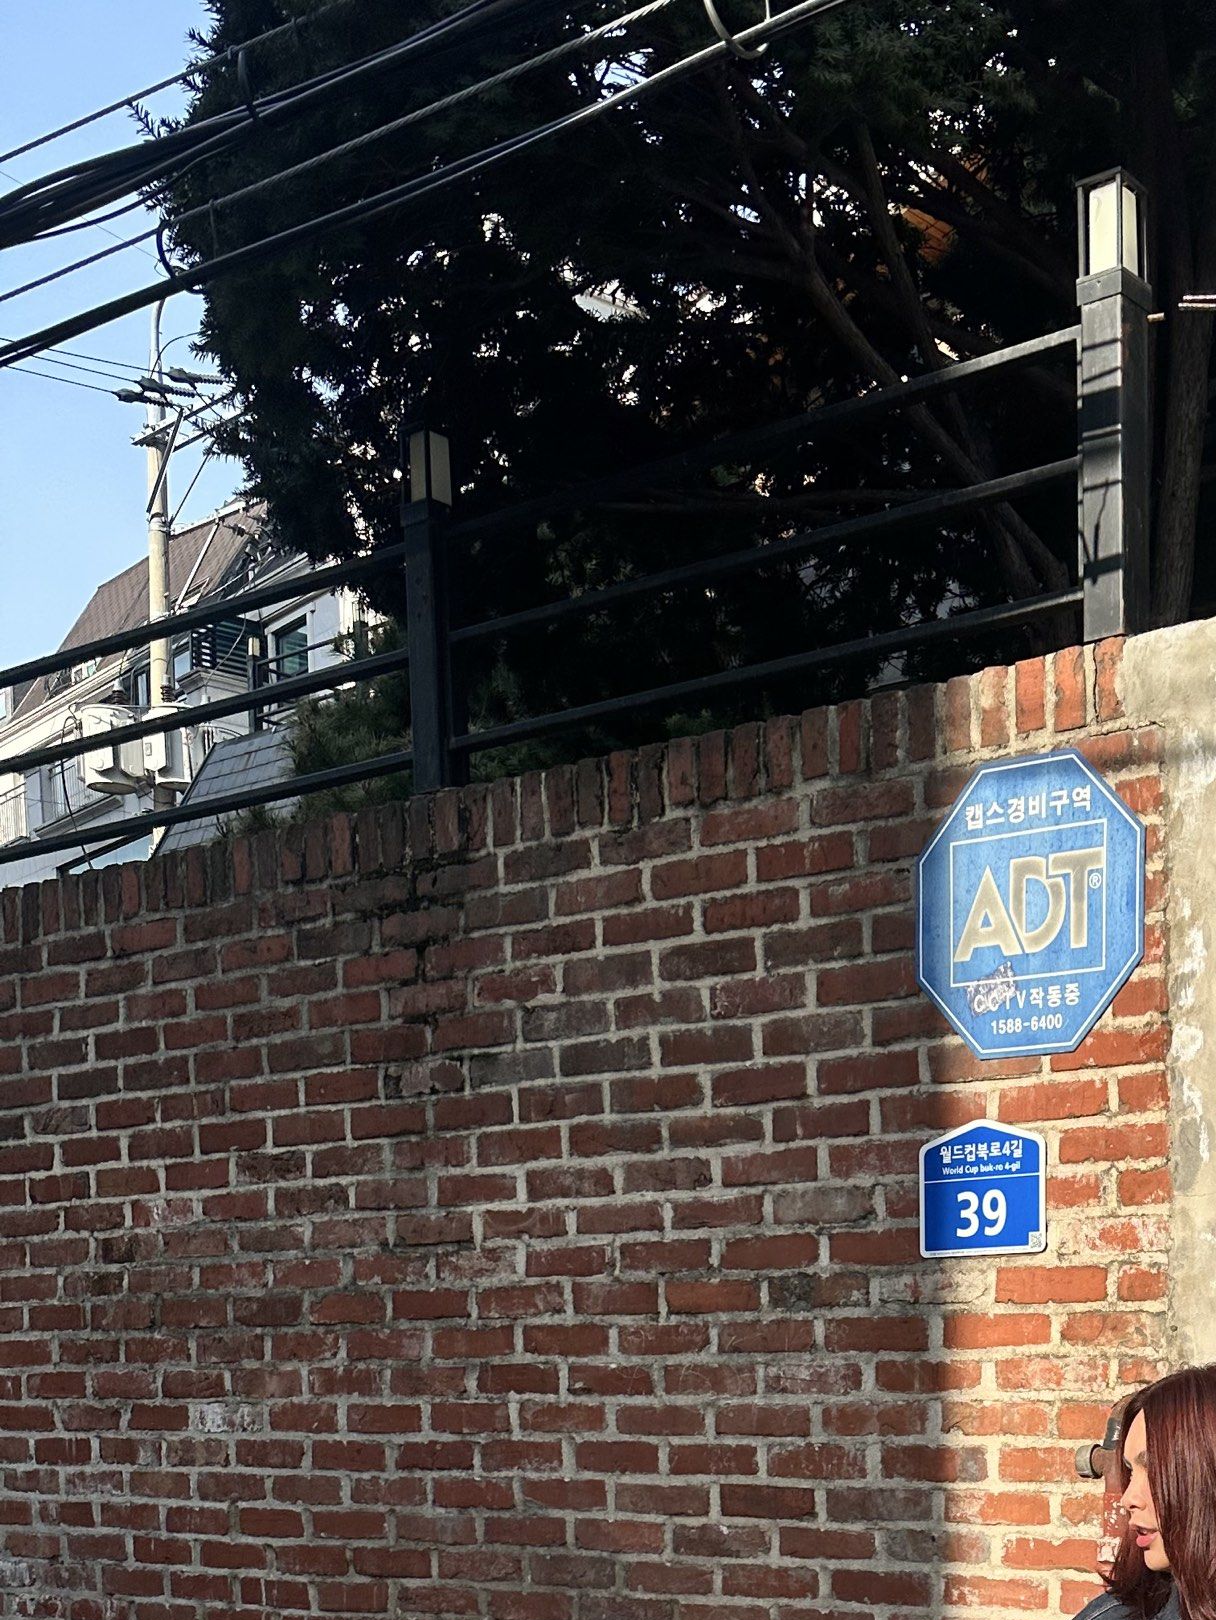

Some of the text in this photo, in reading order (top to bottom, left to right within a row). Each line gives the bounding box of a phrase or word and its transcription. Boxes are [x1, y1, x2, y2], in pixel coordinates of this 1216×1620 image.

[964, 785, 1092, 831] 캡스경비구역
[953, 846, 1105, 962] ADT
[990, 1013, 1063, 1035] 1588-6400
[939, 1139, 1023, 1164] 월드컵북로4길
[942, 1161, 1021, 1176] World Cup buk-ro 4-gil
[956, 1188, 1008, 1238] 39
